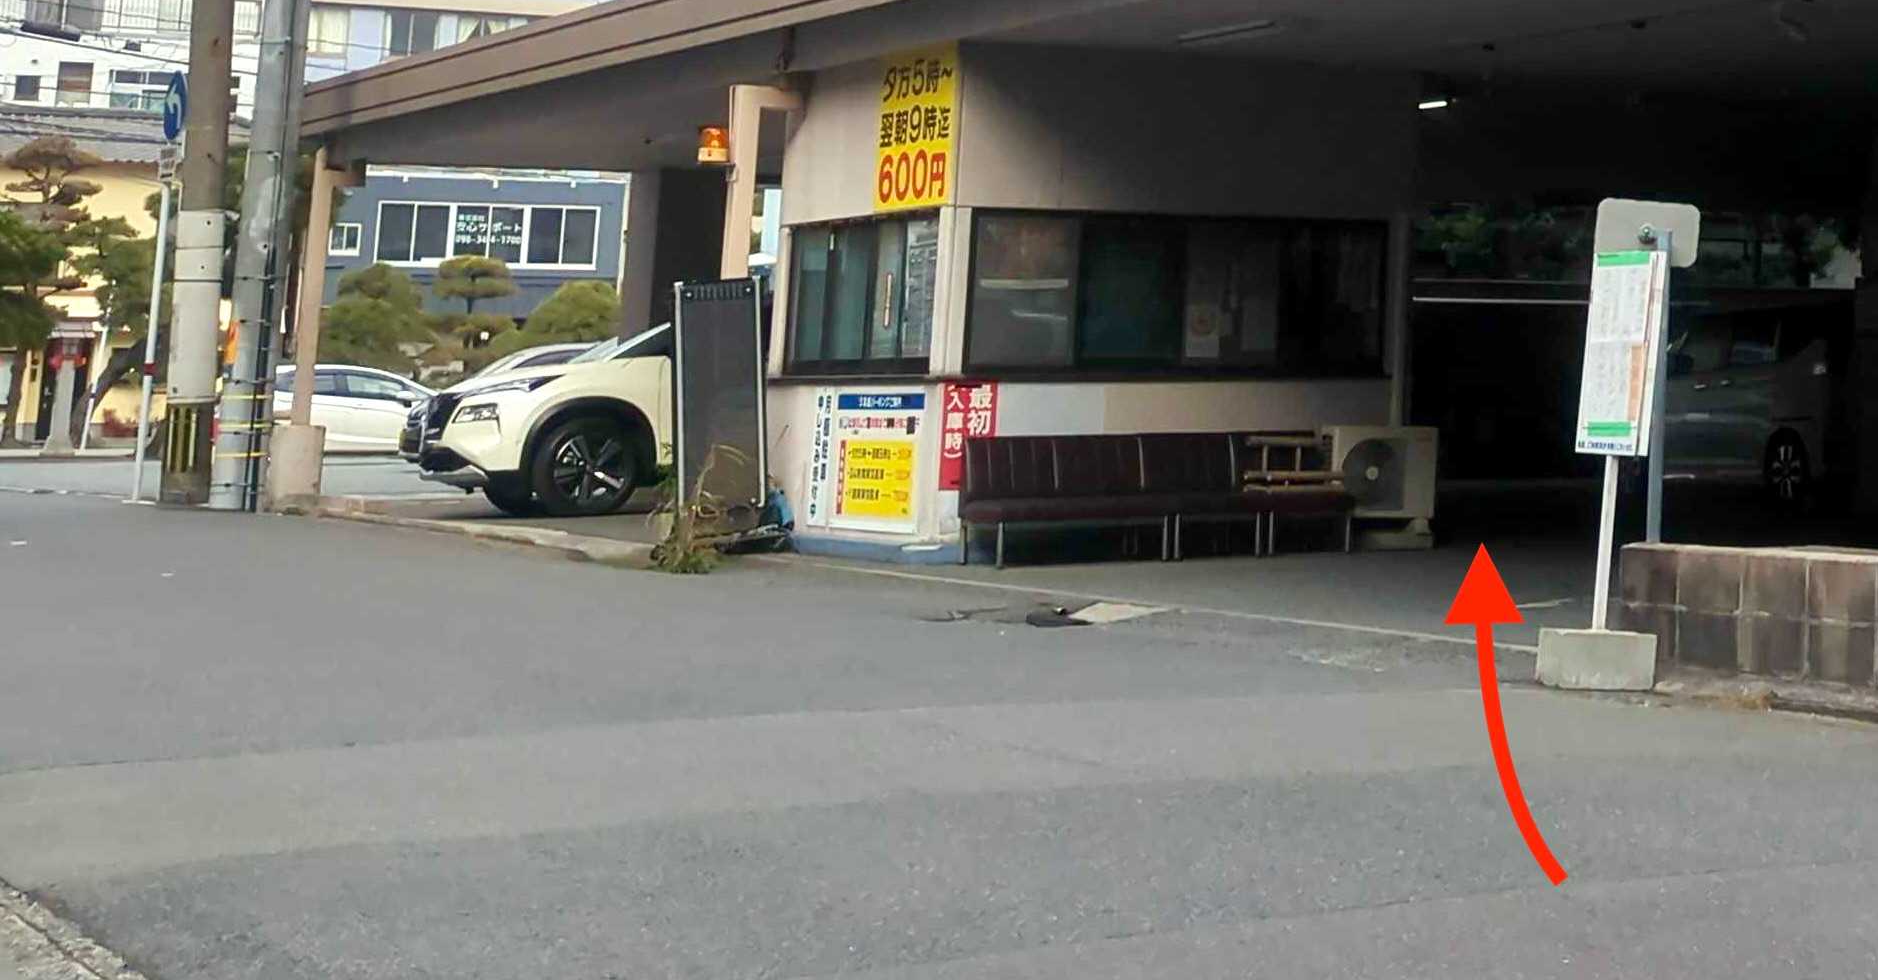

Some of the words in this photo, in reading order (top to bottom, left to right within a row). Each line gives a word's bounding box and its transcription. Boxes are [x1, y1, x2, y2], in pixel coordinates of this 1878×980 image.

[880, 104, 951, 148] 翌朝9時迄
[879, 149, 946, 204] 600円
[967, 384, 993, 436] 最初
